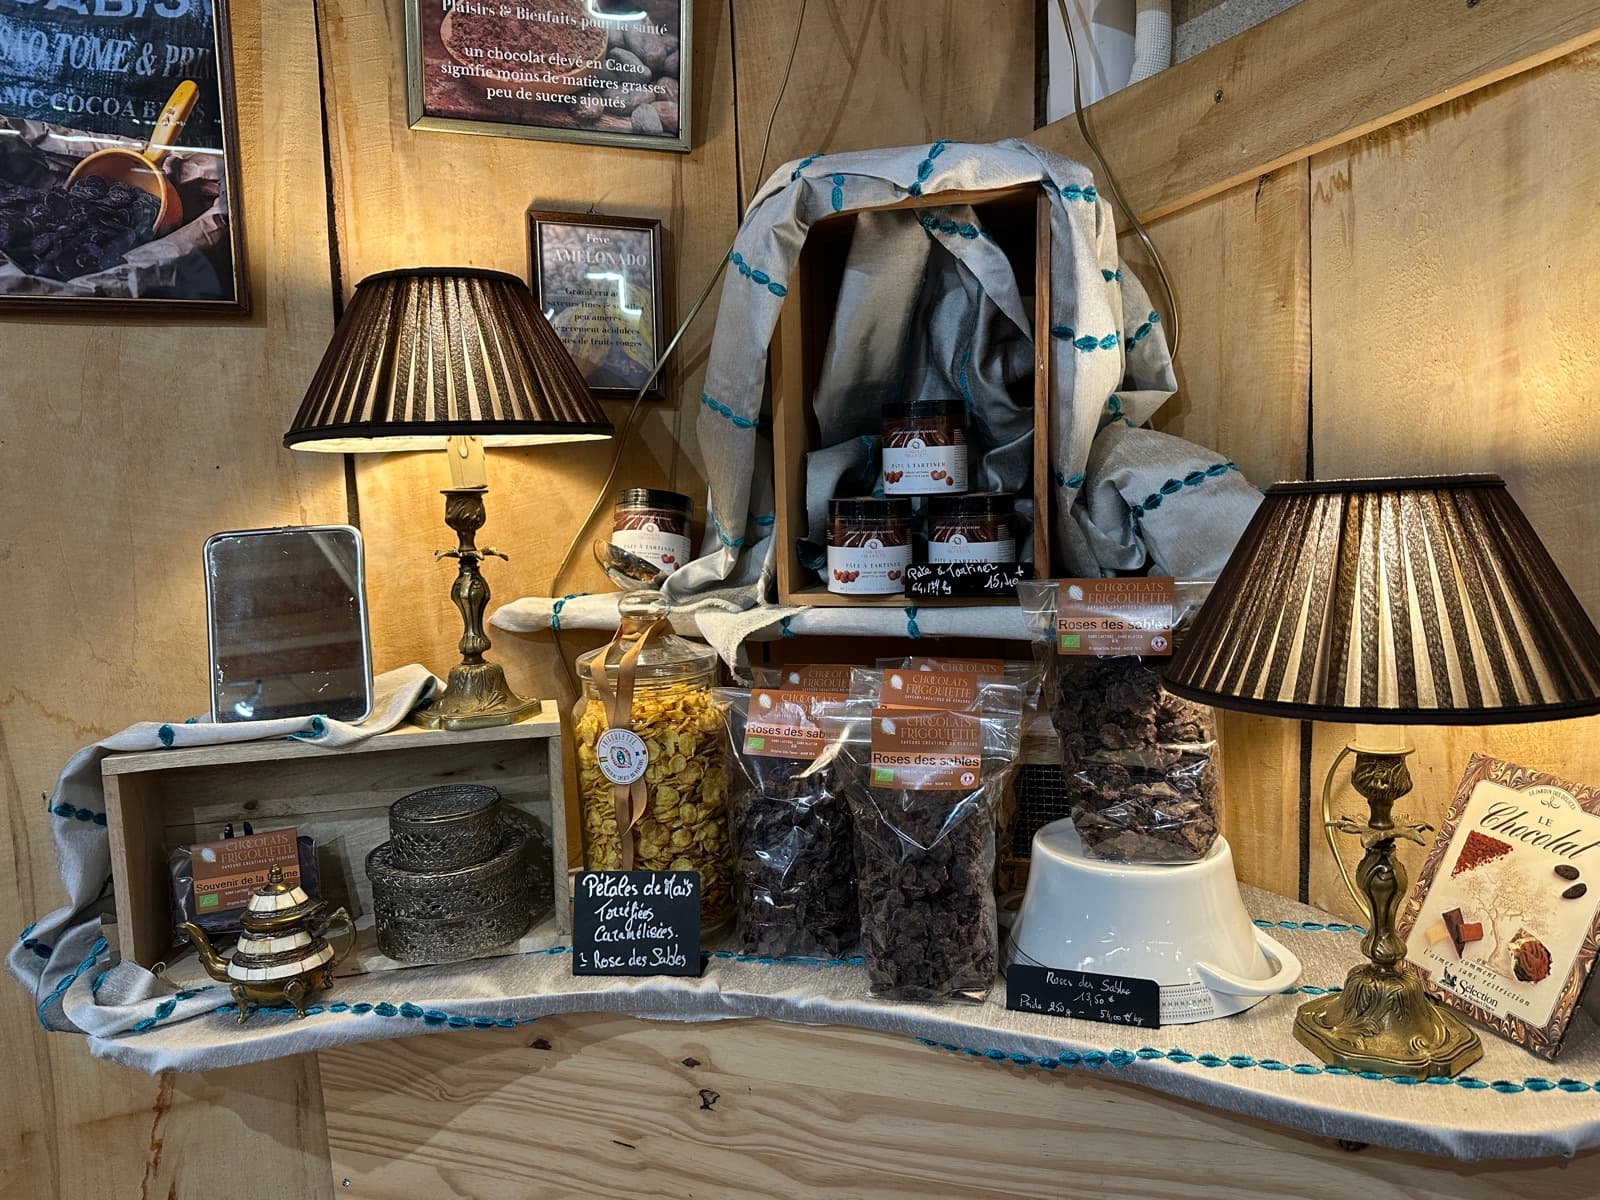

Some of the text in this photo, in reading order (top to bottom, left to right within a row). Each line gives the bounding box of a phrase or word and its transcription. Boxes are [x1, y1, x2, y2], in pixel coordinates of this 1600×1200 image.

[442, 0, 495, 17] Plaisirs
[500, 4, 512, 18] &
[516, 6, 577, 26] Bienfaits
[616, 17, 628, 32] la
[632, 22, 668, 36] santé
[136, 42, 158, 77] &
[463, 46, 645, 74] un chocolat élevé en Cacao
[441, 61, 667, 95] signifie moins de matières grasses
[50, 91, 135, 118] COCOA
[486, 86, 627, 109] peu de sucres ajoutés
[554, 247, 647, 267] AMELONADO
[1058, 619, 1097, 630] Roses
[1101, 619, 1124, 630] des
[747, 724, 781, 736] Roses
[784, 727, 803, 737] des
[873, 753, 980, 767] Roses des sables
[1480, 801, 1600, 859] Chocolat
[1537, 816, 1553, 827] LE
[196, 880, 239, 893] Souvenir
[241, 875, 253, 885] de
[255, 874, 264, 883] la
[582, 873, 693, 899] Pétales de Maïs
[593, 943, 686, 969] Rose des Sables
[1423, 948, 1531, 1007] l'aimer sans restriction
[1460, 959, 1497, 980] comment
[1046, 971, 1132, 995] Roses des Sables
[1459, 979, 1499, 1008] Sélection
